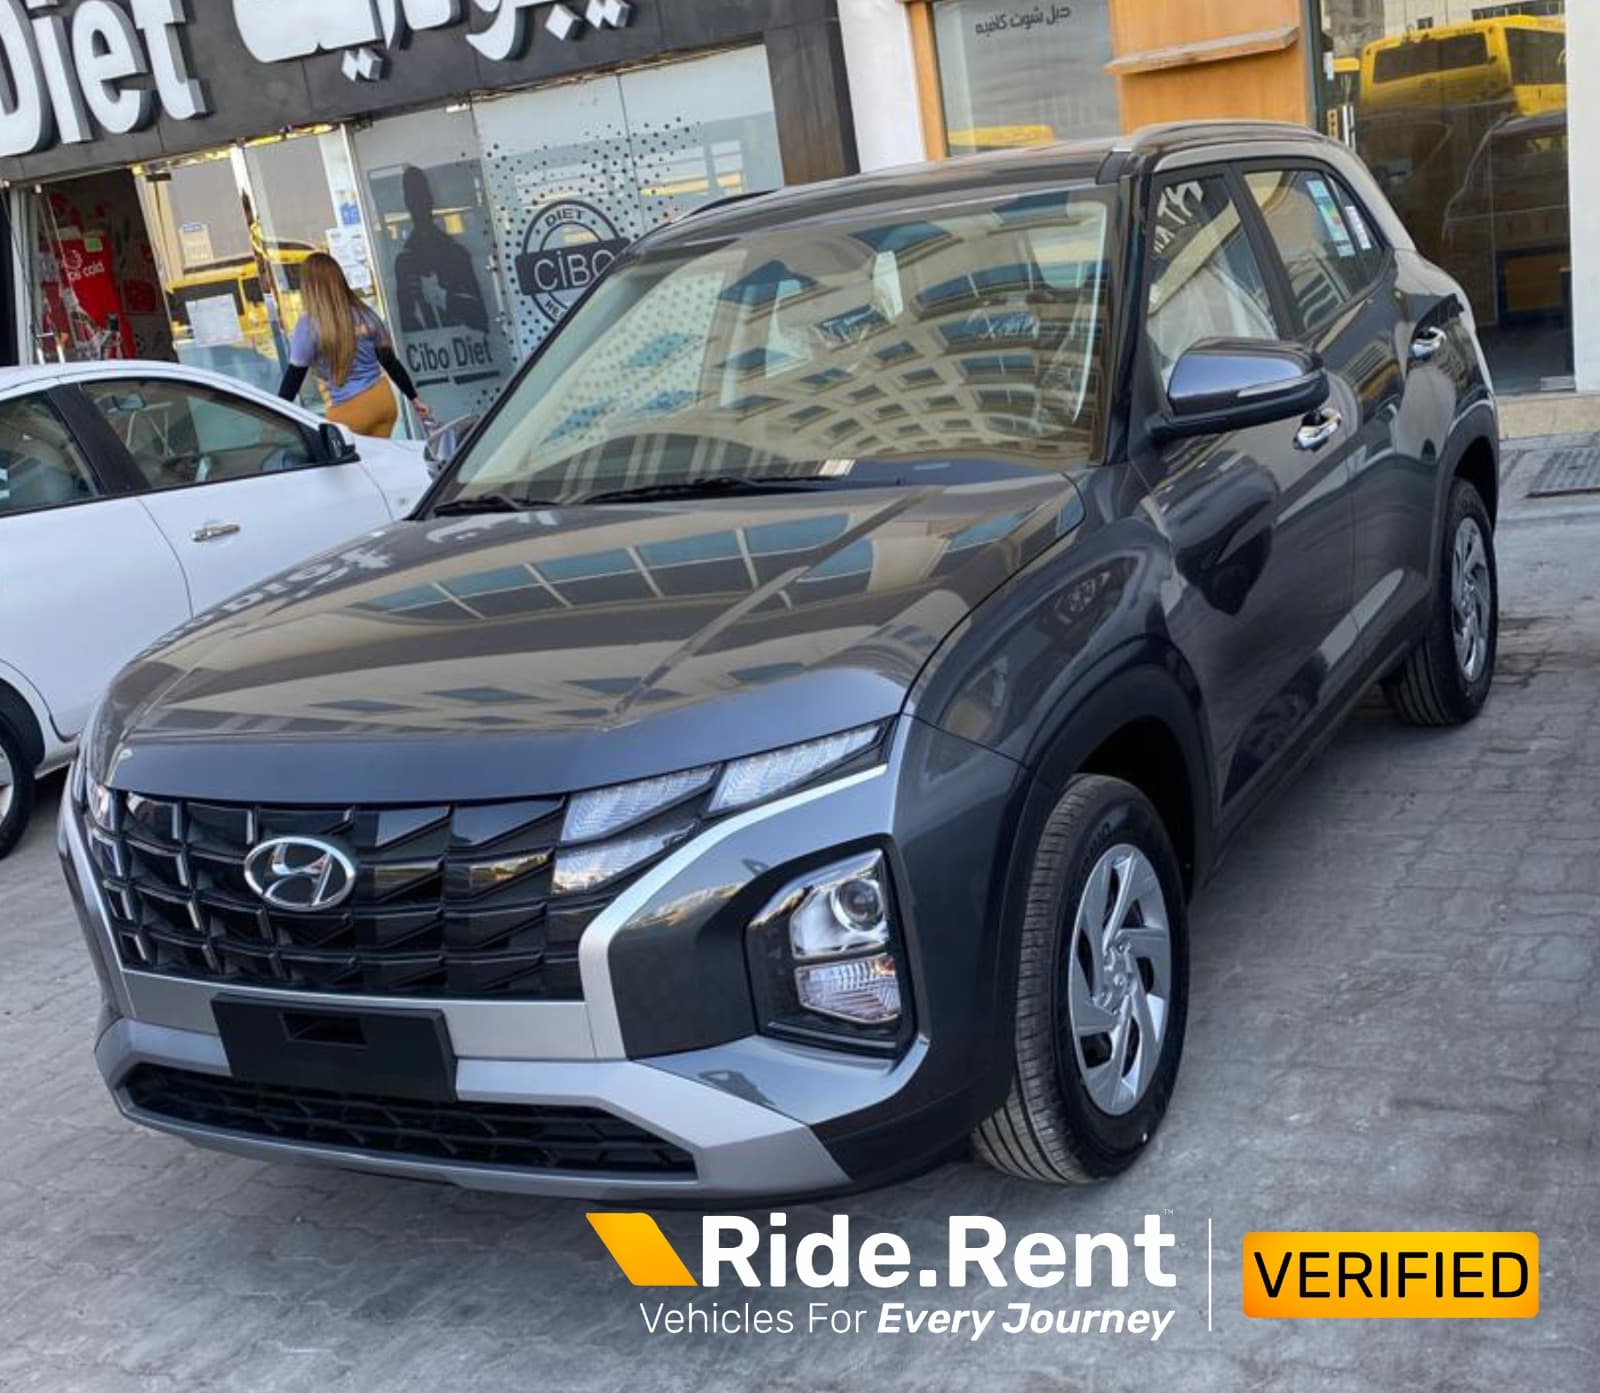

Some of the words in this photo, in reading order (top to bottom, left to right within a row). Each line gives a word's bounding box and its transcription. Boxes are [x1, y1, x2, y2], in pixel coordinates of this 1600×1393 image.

[544, 208, 584, 227] DIET
[405, 342, 450, 373] Cibo
[452, 335, 494, 367] Diet
